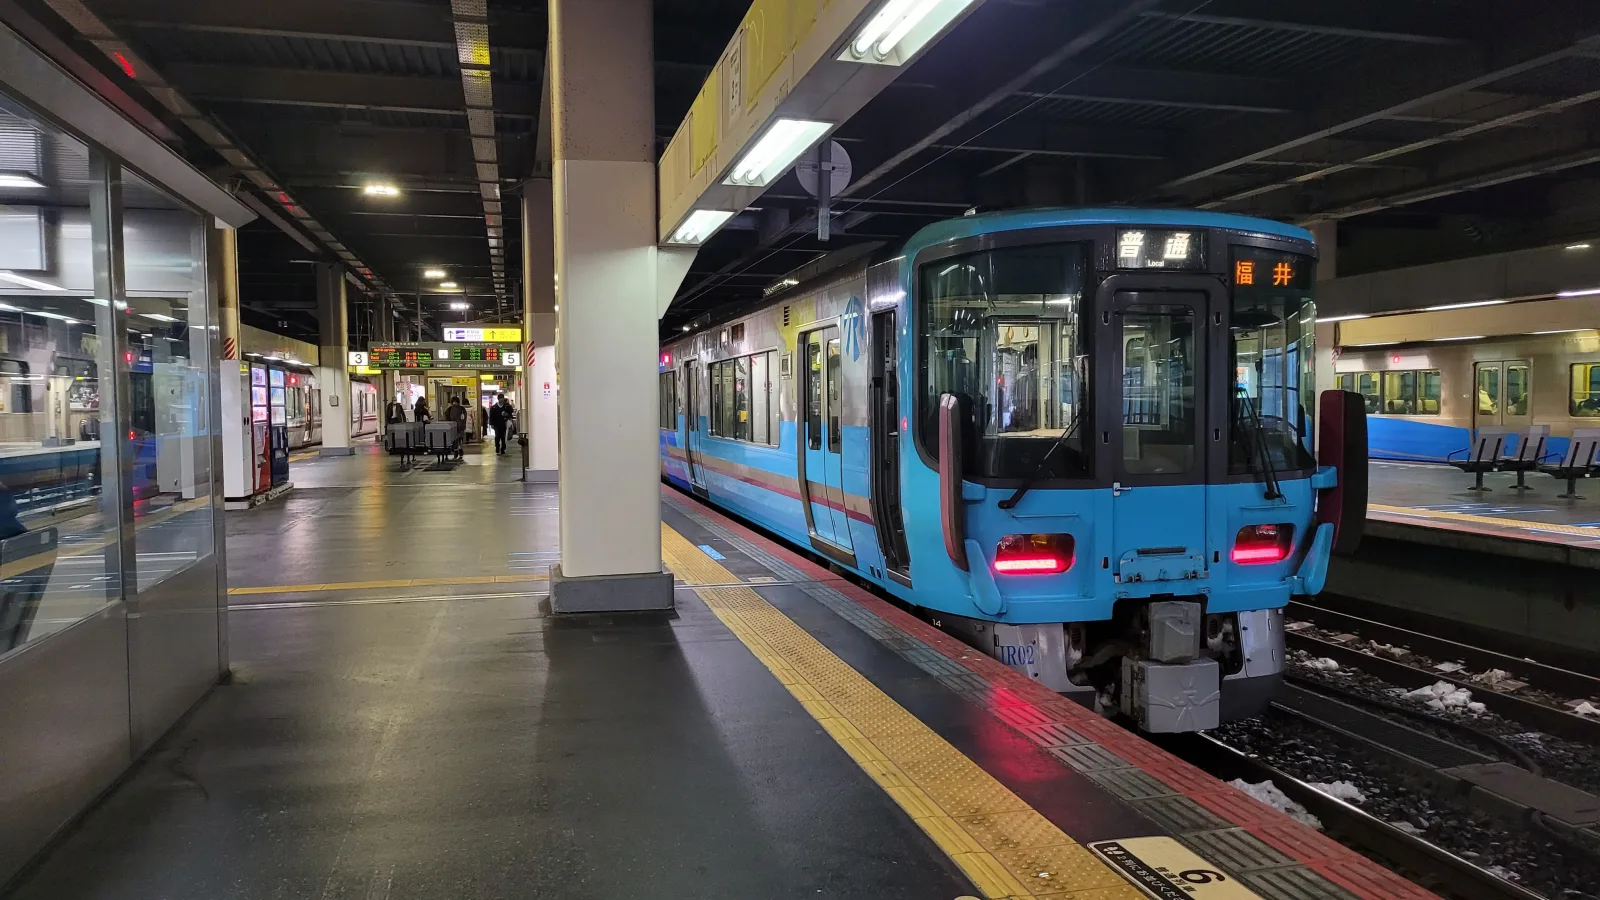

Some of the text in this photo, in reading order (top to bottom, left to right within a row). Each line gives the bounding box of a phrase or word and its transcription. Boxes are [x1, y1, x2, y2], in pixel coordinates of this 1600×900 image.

[1119, 231, 1191, 259] 普通
[1147, 259, 1165, 267] Local
[1236, 260, 1293, 286] 福井
[355, 353, 363, 364] 3
[507, 354, 515, 364] 5
[932, 618, 941, 627] 14
[1000, 645, 1035, 666] IR02
[1178, 869, 1226, 884] 6
